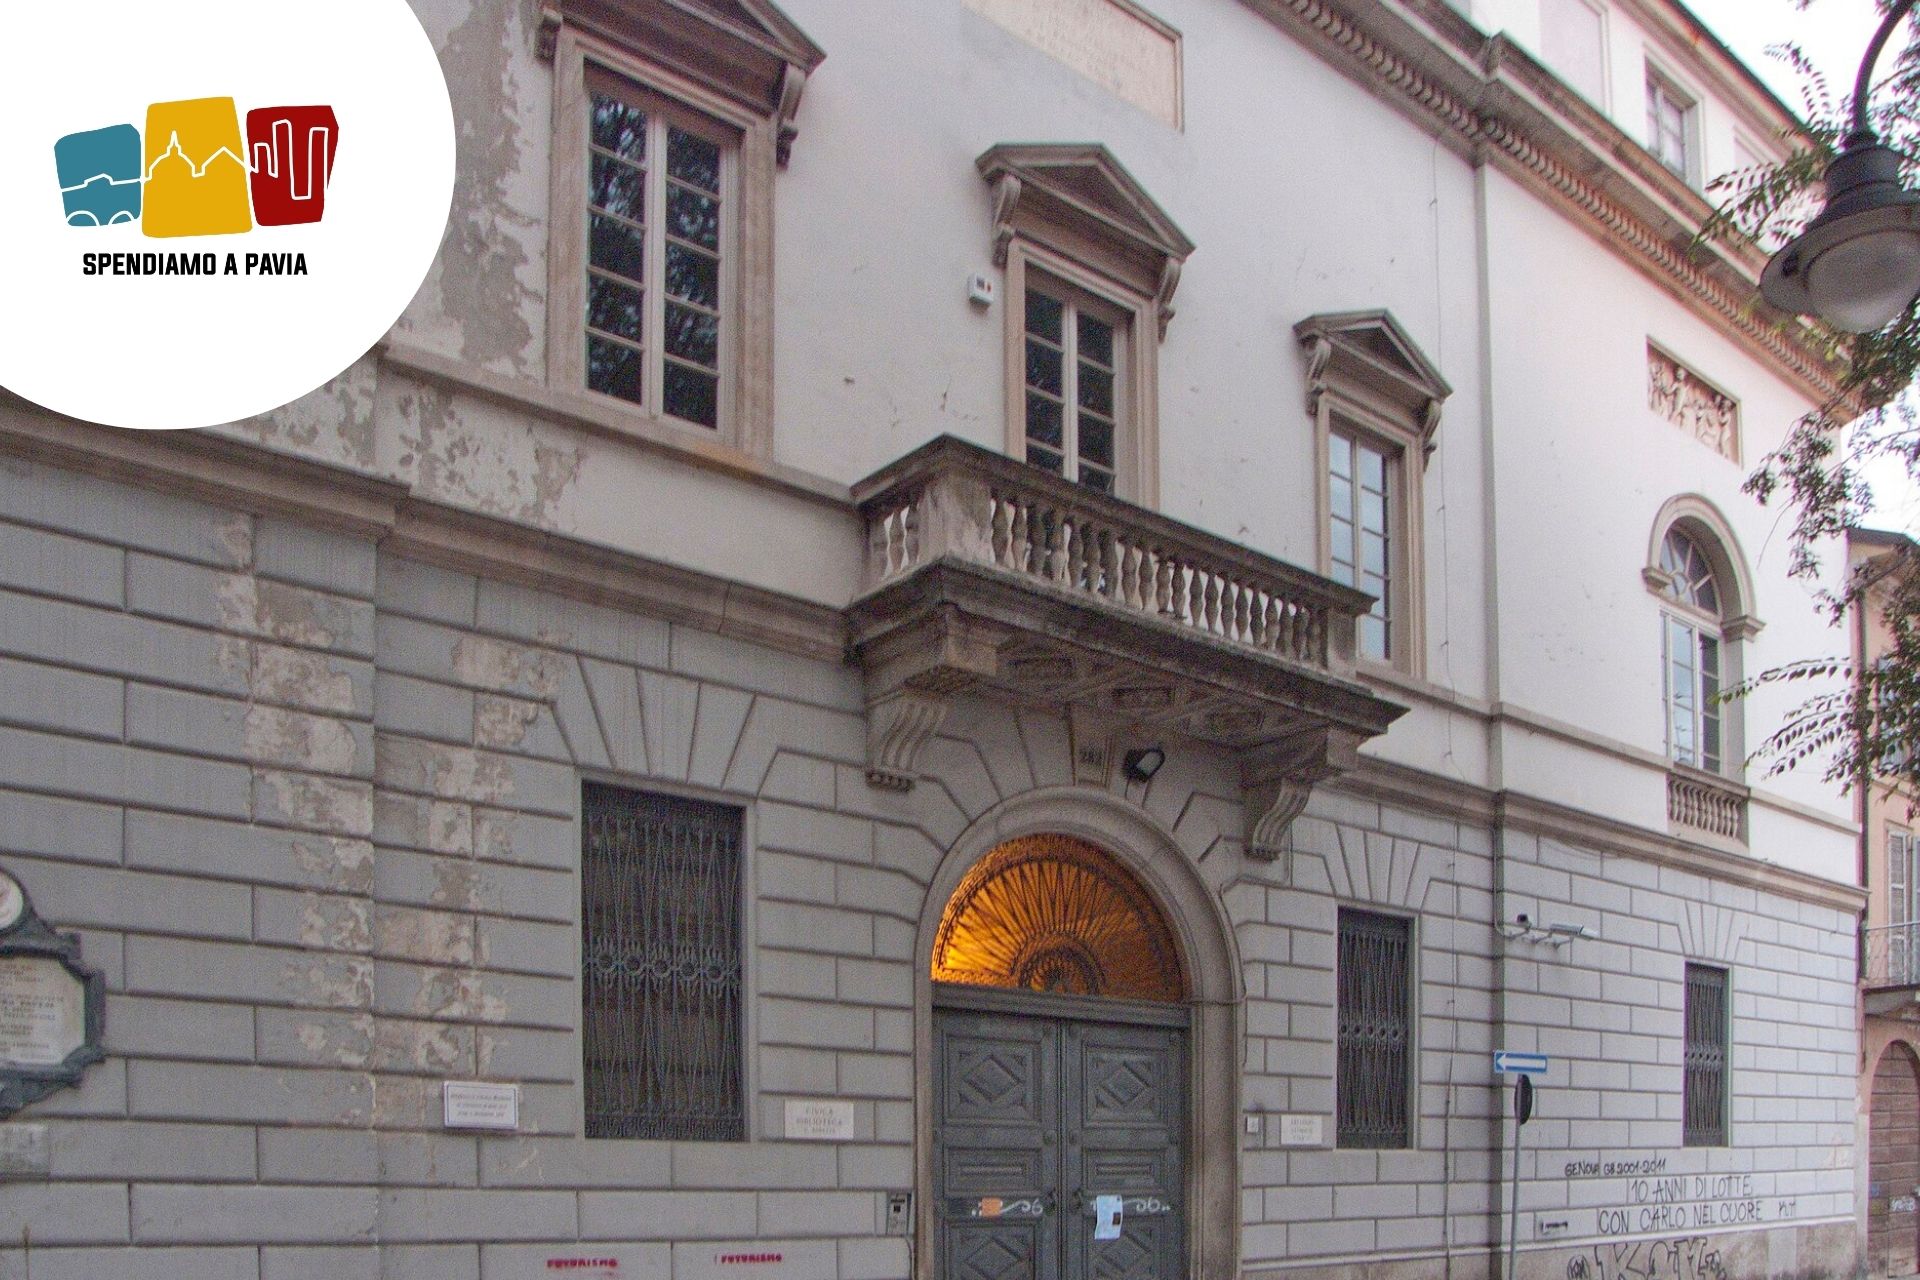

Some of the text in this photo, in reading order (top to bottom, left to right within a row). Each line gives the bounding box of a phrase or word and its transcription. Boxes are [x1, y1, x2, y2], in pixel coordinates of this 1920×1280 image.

[1631, 1174, 1751, 1203] 10 ANNI DI LOTTE
[1599, 1208, 1629, 1235] CON
[1640, 1206, 1687, 1232] CARLO
[1693, 1204, 1716, 1227] NEL
[1720, 1200, 1763, 1223] CUORE
[720, 1254, 782, 1264] FUTURISMO
